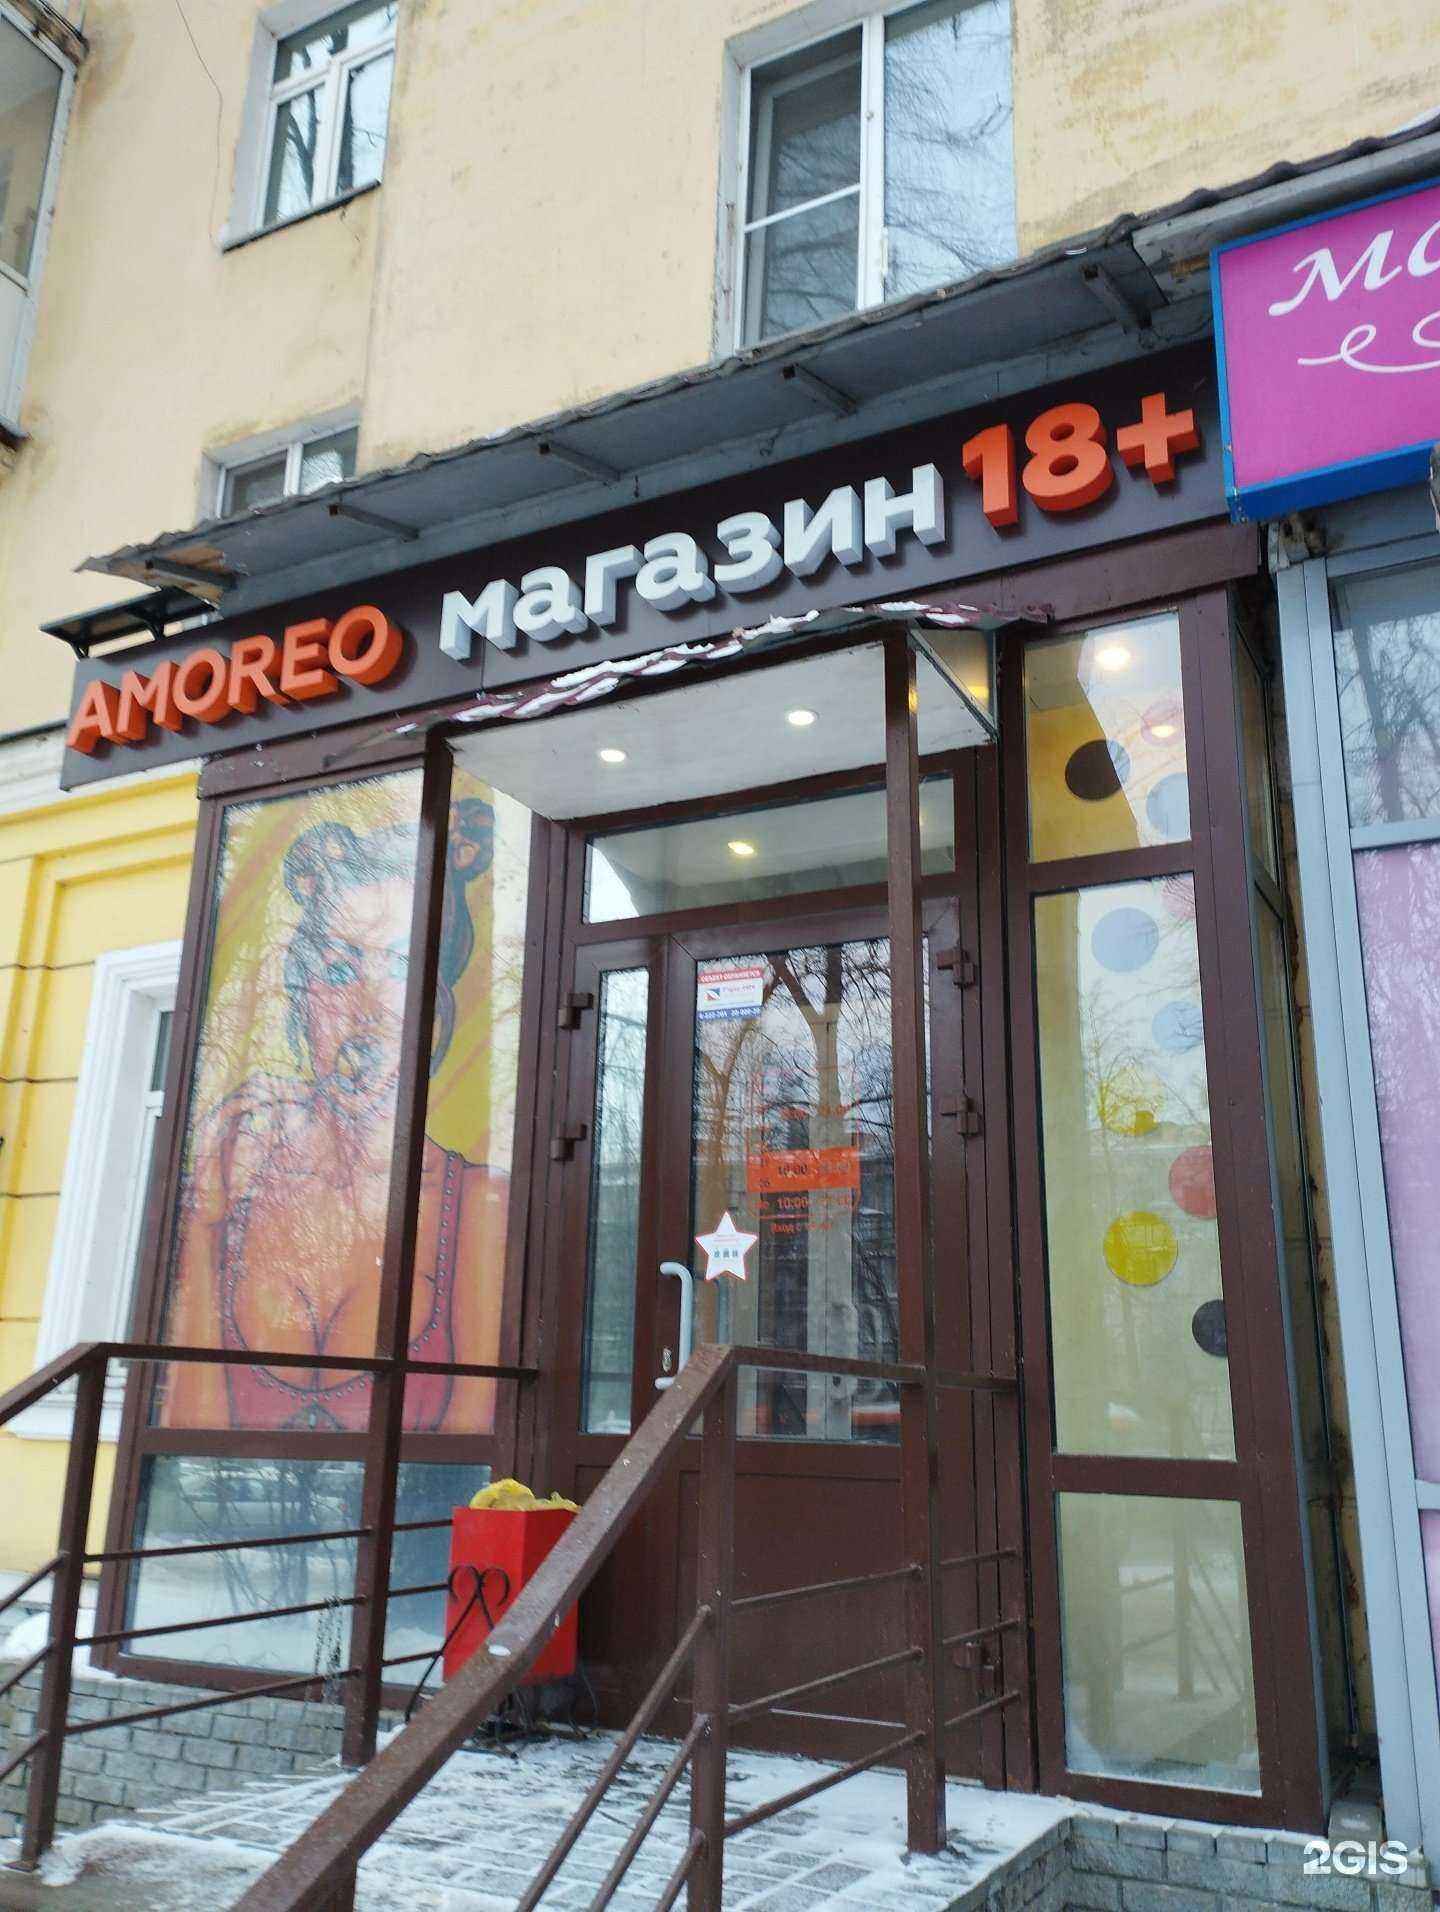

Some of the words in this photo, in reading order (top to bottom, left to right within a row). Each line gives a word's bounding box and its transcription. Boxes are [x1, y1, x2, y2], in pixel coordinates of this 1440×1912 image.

[65, 604, 404, 755] AMOREO
[438, 462, 946, 661] магазин
[961, 392, 1198, 528] 18+
